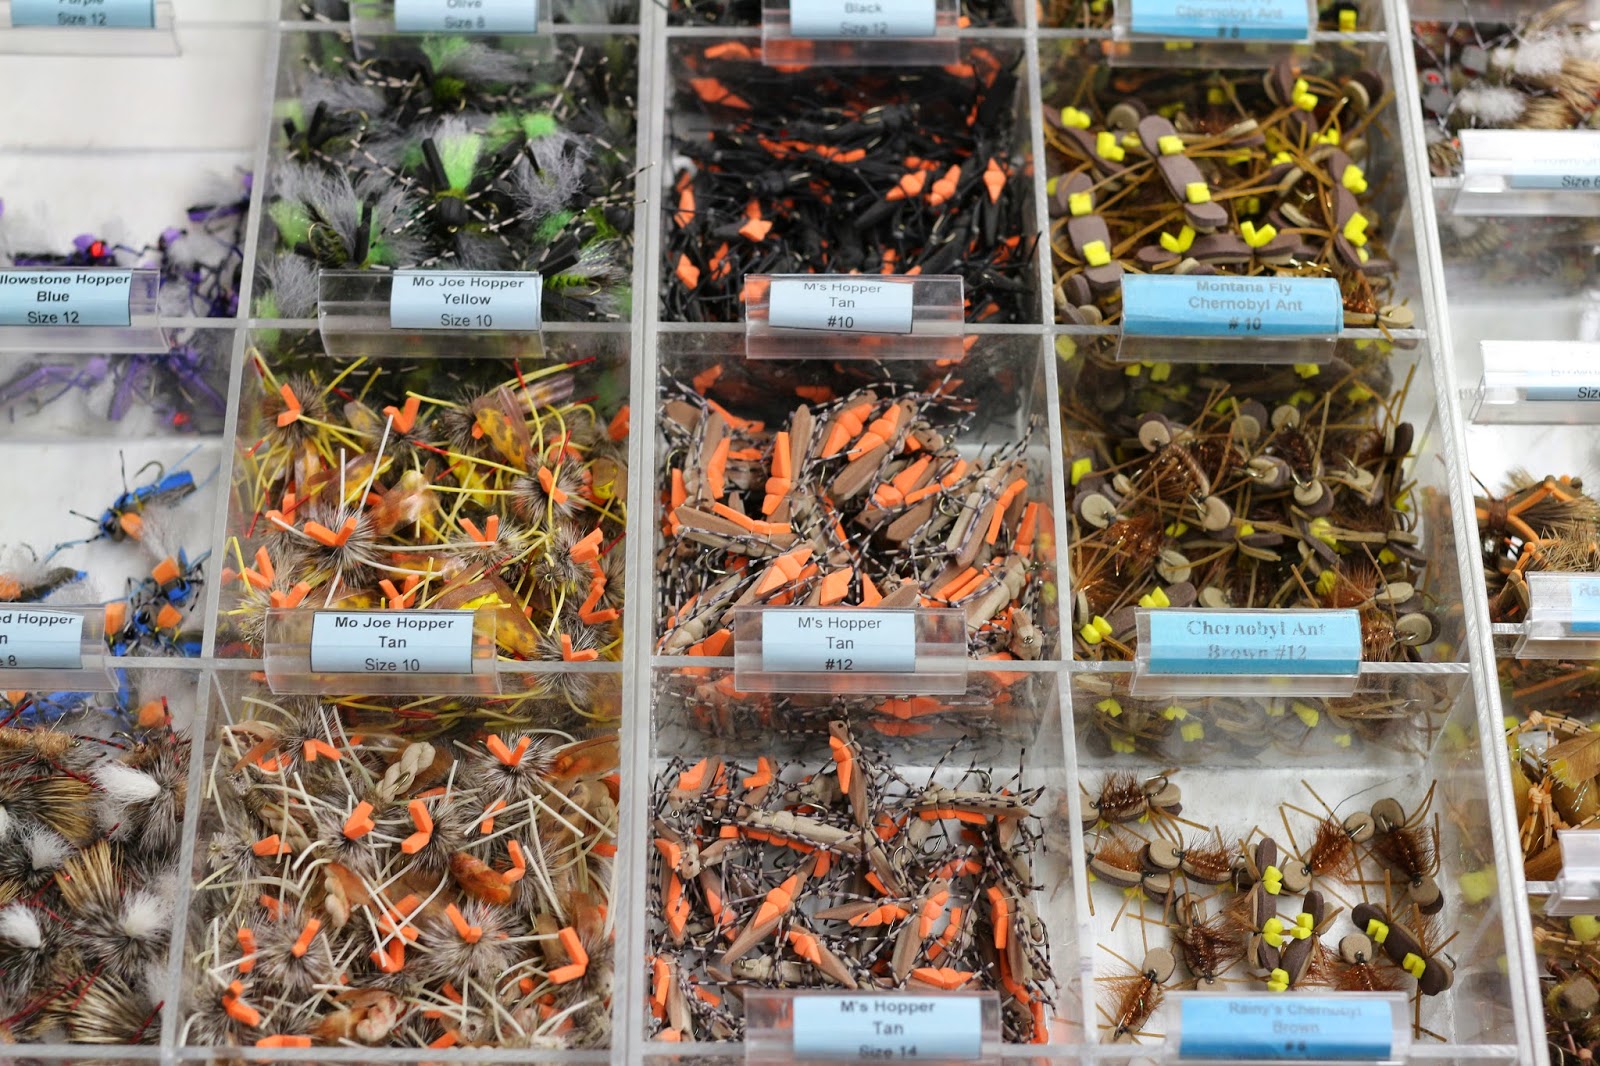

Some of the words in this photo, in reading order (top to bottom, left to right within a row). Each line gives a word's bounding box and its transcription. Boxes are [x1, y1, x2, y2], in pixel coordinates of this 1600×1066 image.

[446, 0, 483, 9] Olive
[844, 2, 882, 14] Black
[57, 12, 87, 26] Size
[91, 12, 107, 26] 12
[444, 16, 472, 29] Size
[840, 22, 868, 35] Size
[873, 22, 888, 35] 12
[1561, 175, 1590, 188] Size
[76, 274, 130, 286] Hopper
[412, 277, 434, 287] Mo
[439, 277, 465, 287] Joe
[470, 278, 524, 290] Hopper
[804, 283, 827, 291] M's
[832, 283, 882, 294] Hopper
[1196, 281, 1264, 293] Montana
[1270, 282, 1292, 296] Fly
[37, 291, 70, 302] Blue
[443, 294, 491, 305] Yellow
[829, 297, 855, 308] Tan
[1188, 296, 1270, 312] Chernobyl
[1276, 300, 1303, 311] Ant
[28, 311, 58, 324] Size
[63, 311, 79, 324] 12
[440, 314, 470, 326] Size
[476, 315, 492, 327] 10
[828, 316, 854, 328] #10
[1245, 318, 1262, 330] 10
[1578, 386, 1600, 399] Siz
[0, 614, 12, 624] d
[18, 614, 75, 626] Hopper
[335, 617, 358, 628] Mo
[363, 617, 391, 628] Joe
[397, 617, 454, 631] Hopper
[798, 617, 823, 628] M's
[828, 617, 881, 631] Hopper
[1187, 620, 1286, 639] Chernobyl
[1292, 621, 1326, 636] Ant
[378, 636, 407, 648] Tan
[826, 637, 854, 649] Tan
[1208, 644, 1269, 660] Brown
[8, 655, 17, 666] 8
[365, 658, 396, 671] Size
[402, 659, 420, 671] 10
[825, 659, 853, 670] #12
[840, 1001, 868, 1012] M's
[875, 1001, 936, 1016] Hopper
[872, 1021, 904, 1035] Tan
[1272, 1020, 1320, 1034] Brown
[858, 1045, 893, 1058] Size
[900, 1045, 918, 1057] 14
